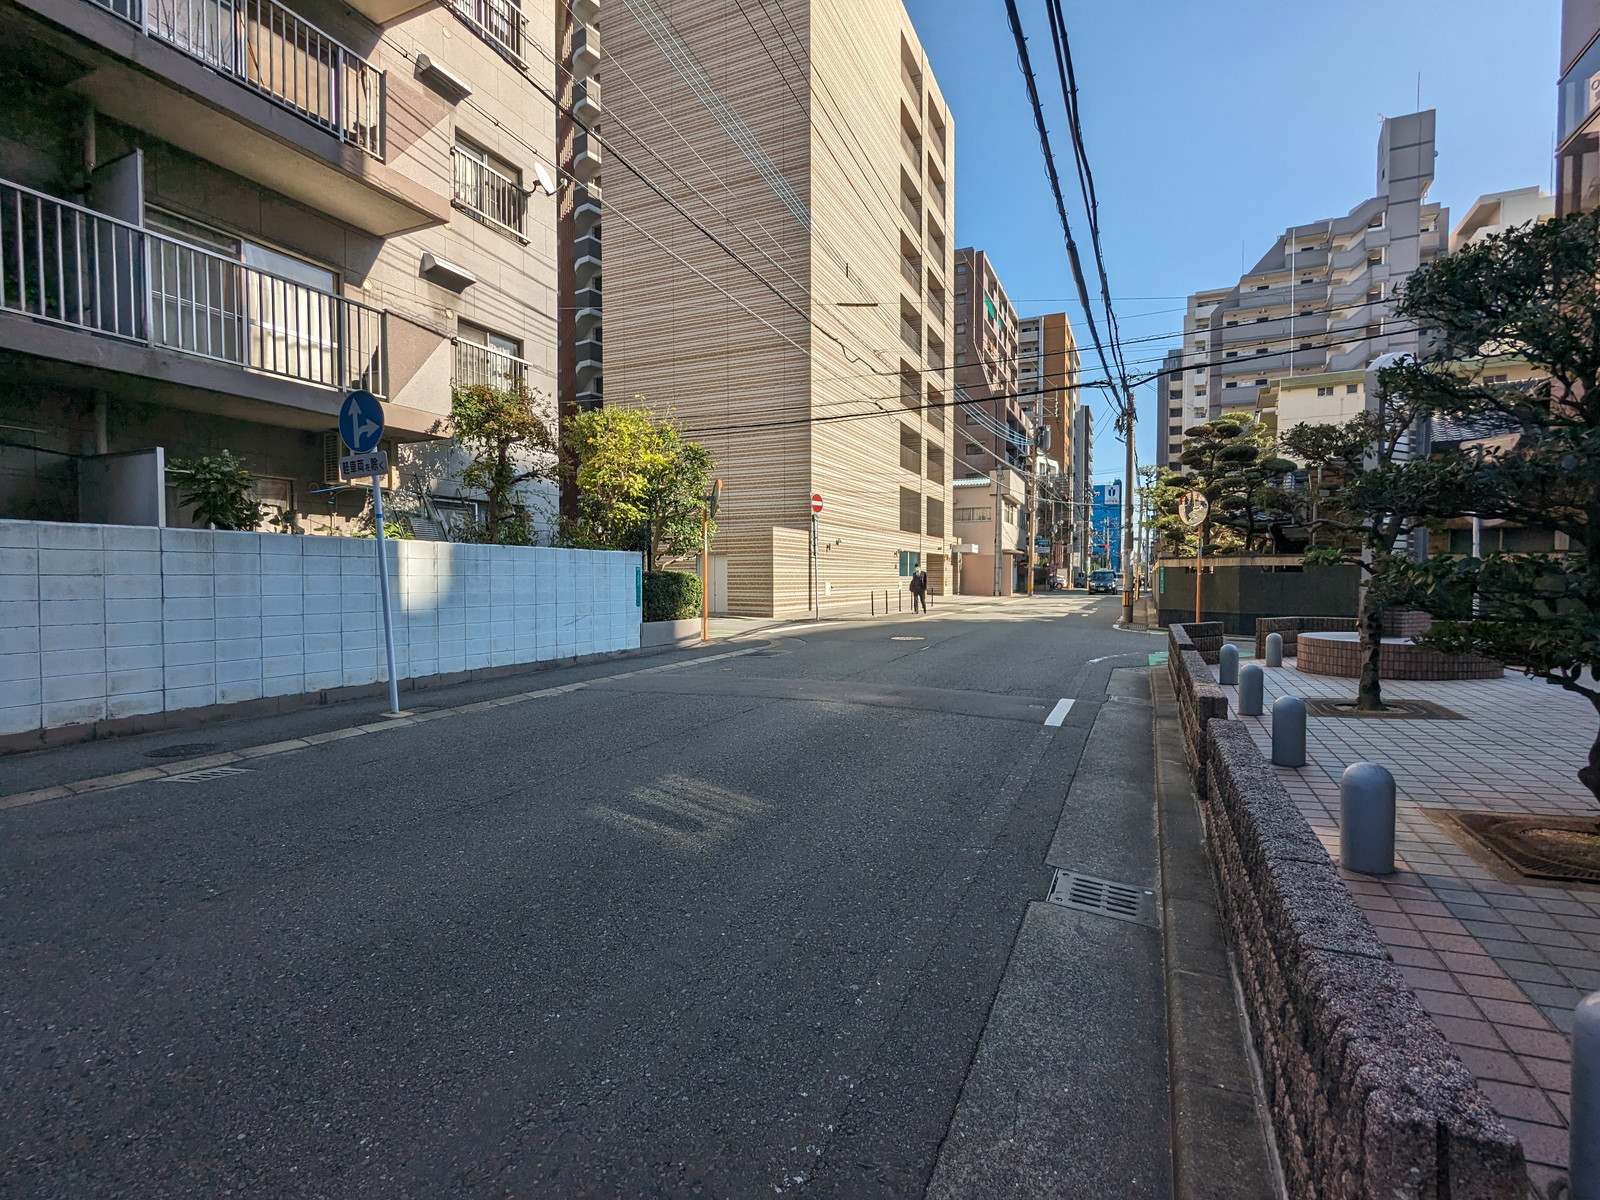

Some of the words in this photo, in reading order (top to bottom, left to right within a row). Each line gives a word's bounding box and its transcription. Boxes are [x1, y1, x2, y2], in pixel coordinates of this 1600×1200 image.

[342, 457, 385, 475] 軽車両を除く
